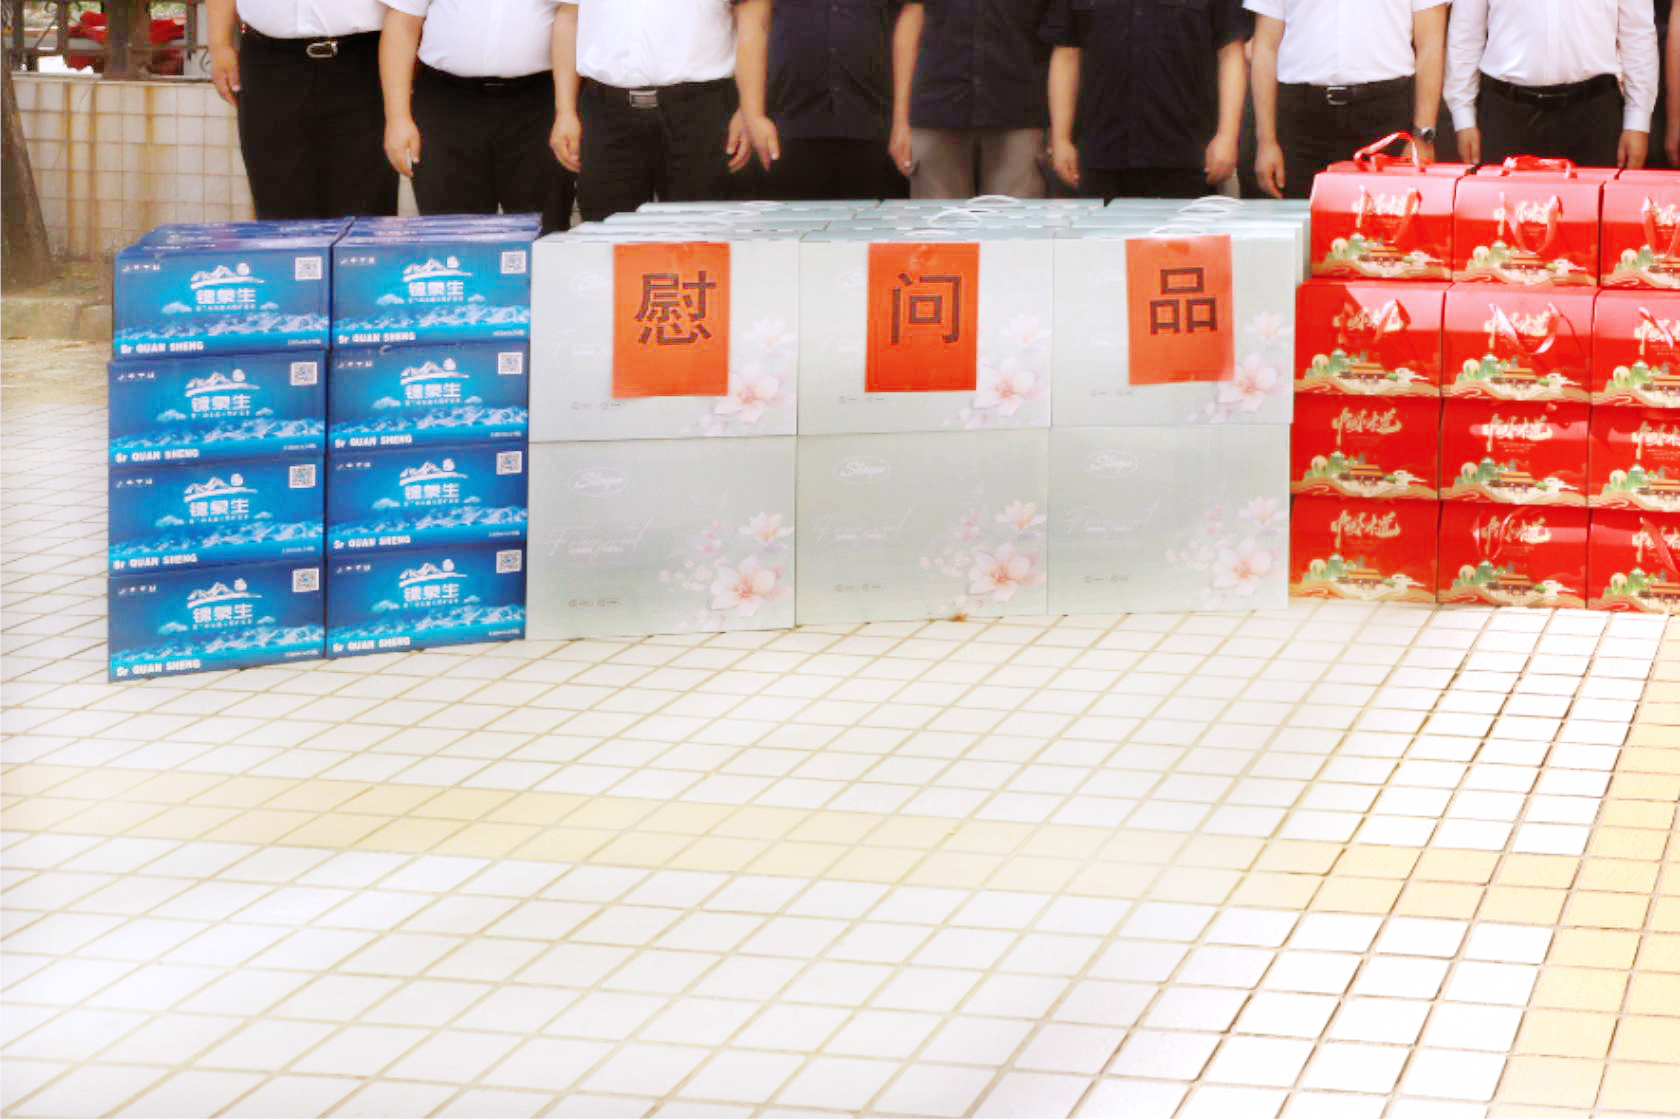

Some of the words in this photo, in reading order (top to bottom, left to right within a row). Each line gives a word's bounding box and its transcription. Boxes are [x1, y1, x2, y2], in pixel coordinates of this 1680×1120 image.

[634, 271, 716, 346] 慰
[890, 273, 962, 346] 问
[1149, 267, 1218, 335] 品
